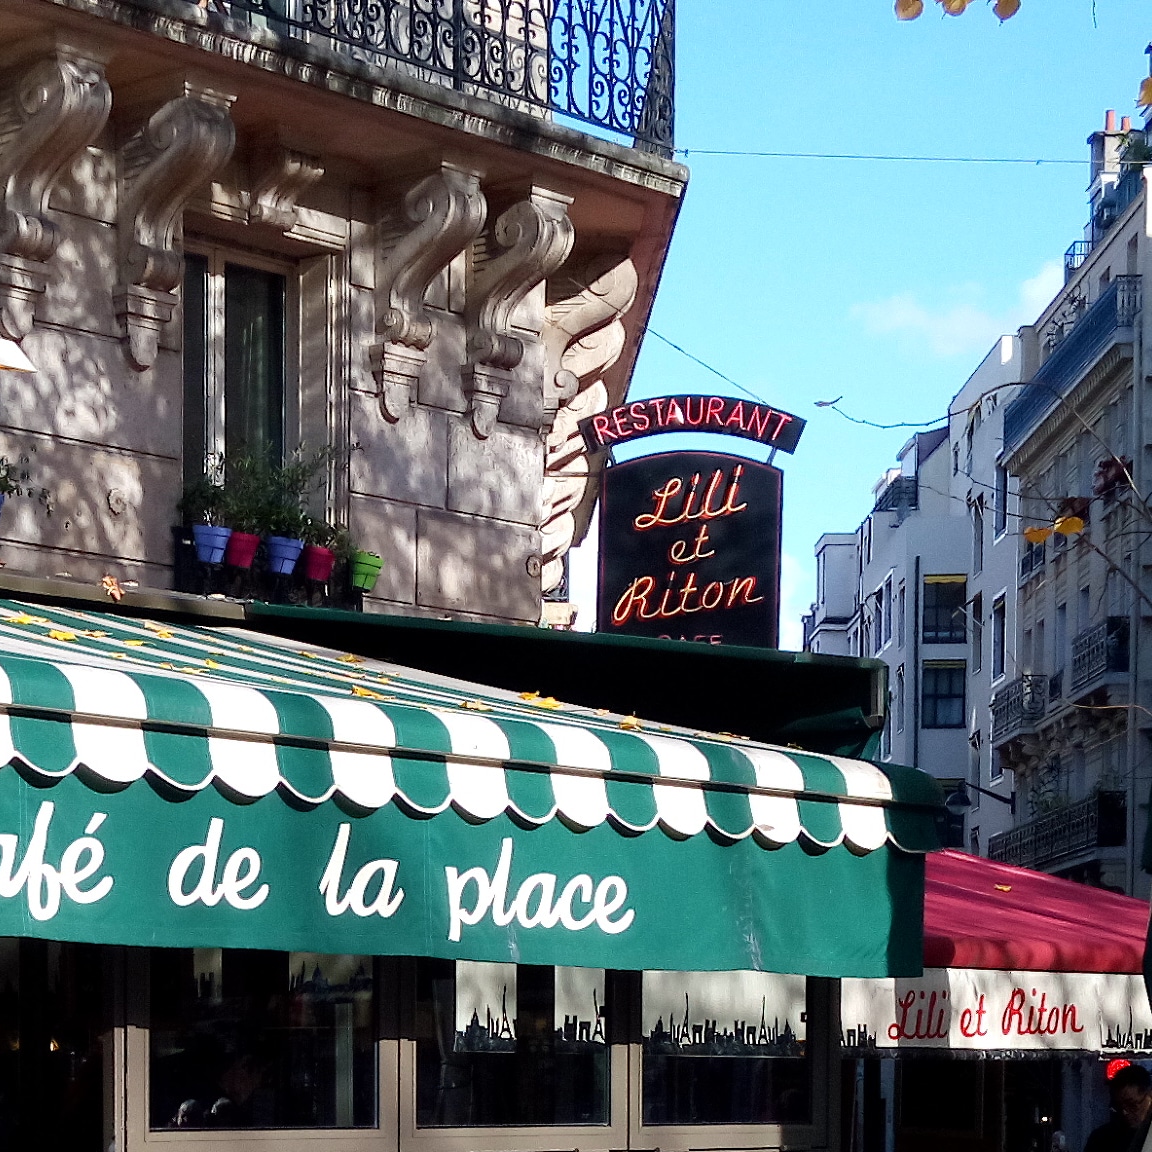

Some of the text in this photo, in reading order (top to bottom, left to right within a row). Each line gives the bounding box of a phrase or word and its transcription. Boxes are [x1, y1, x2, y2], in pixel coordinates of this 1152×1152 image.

[592, 396, 793, 446] RESTAURANT
[634, 463, 748, 530] Lili
[670, 523, 715, 562] et
[612, 570, 764, 627] Riton
[167, 817, 271, 911] de
[319, 822, 405, 919] la
[444, 837, 636, 942] place
[887, 987, 1084, 1040] Lili et Riton
